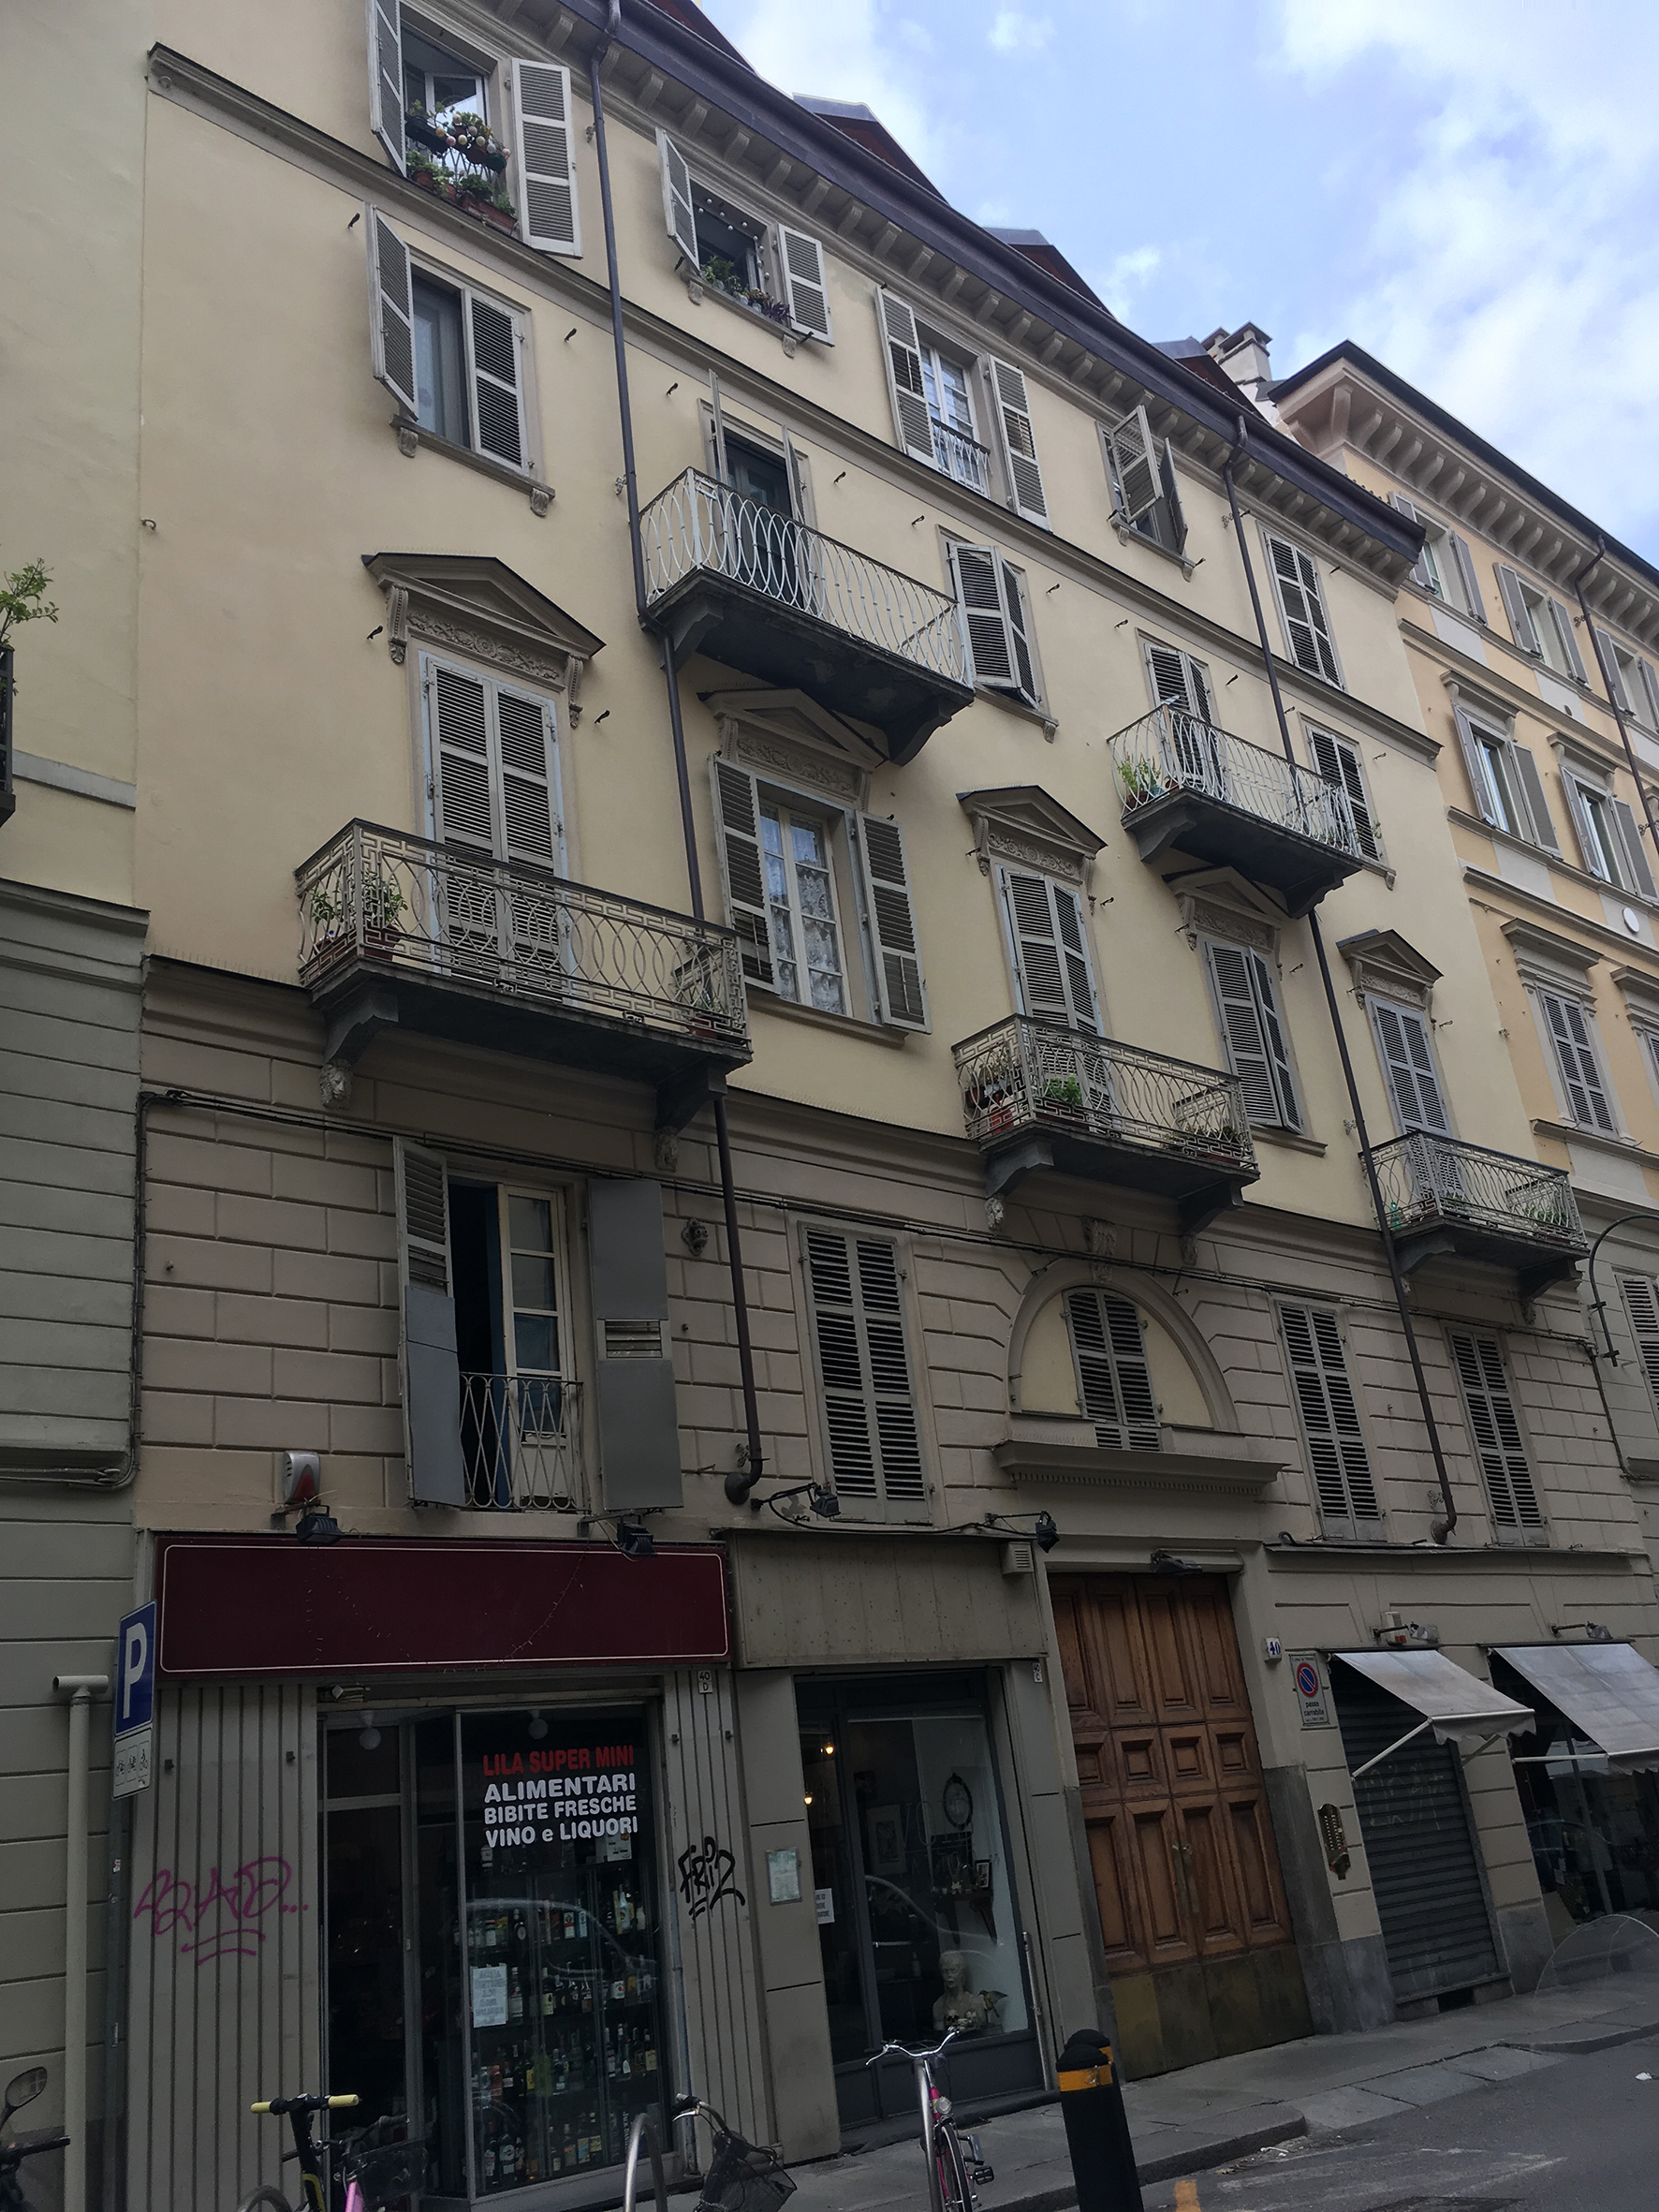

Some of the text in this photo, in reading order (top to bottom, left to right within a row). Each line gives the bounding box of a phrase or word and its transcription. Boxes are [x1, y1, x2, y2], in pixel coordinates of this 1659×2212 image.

[1270, 1642, 1281, 1656] 40
[123, 1622, 147, 1719] P
[699, 1672, 710, 1681] 40
[703, 1682, 709, 1691] D
[482, 1745, 634, 1777] LILA SUPER MINI
[484, 1772, 636, 1804] ALIMENTARI
[484, 1794, 637, 1824] BIBITE FRESCHE
[485, 1816, 639, 1848] VINO e LIQUORI
